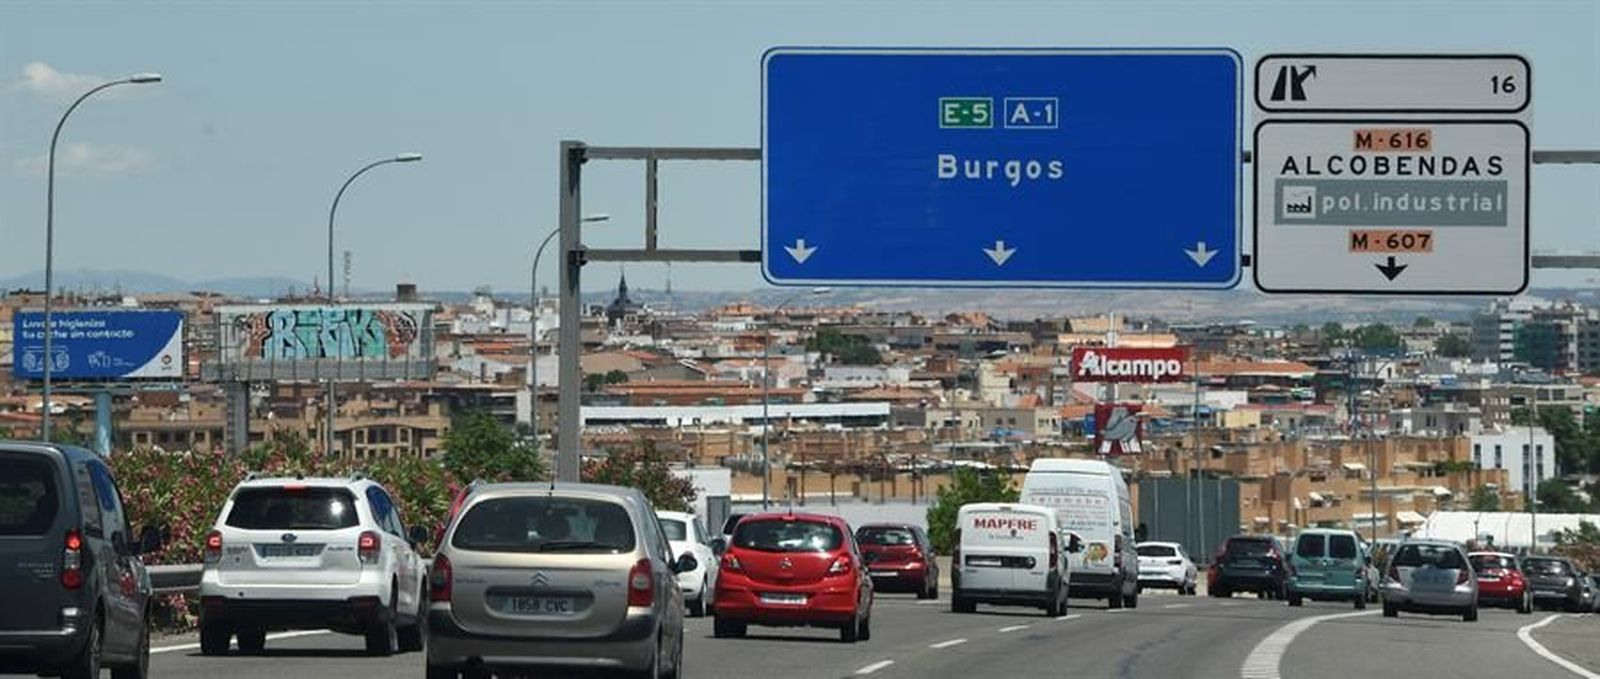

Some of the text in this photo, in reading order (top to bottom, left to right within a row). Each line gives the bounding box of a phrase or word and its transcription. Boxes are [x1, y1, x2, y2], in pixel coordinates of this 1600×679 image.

[1490, 75, 1516, 94] 16
[943, 102, 1053, 124] E-5 A-1
[1355, 132, 1429, 149] M-616
[938, 154, 1064, 187] Burgos
[1280, 155, 1504, 176] ALCOBENDAS
[1352, 233, 1431, 250] M-607
[1078, 350, 1182, 380] Alcampo
[974, 517, 1037, 531] MAPFRE
